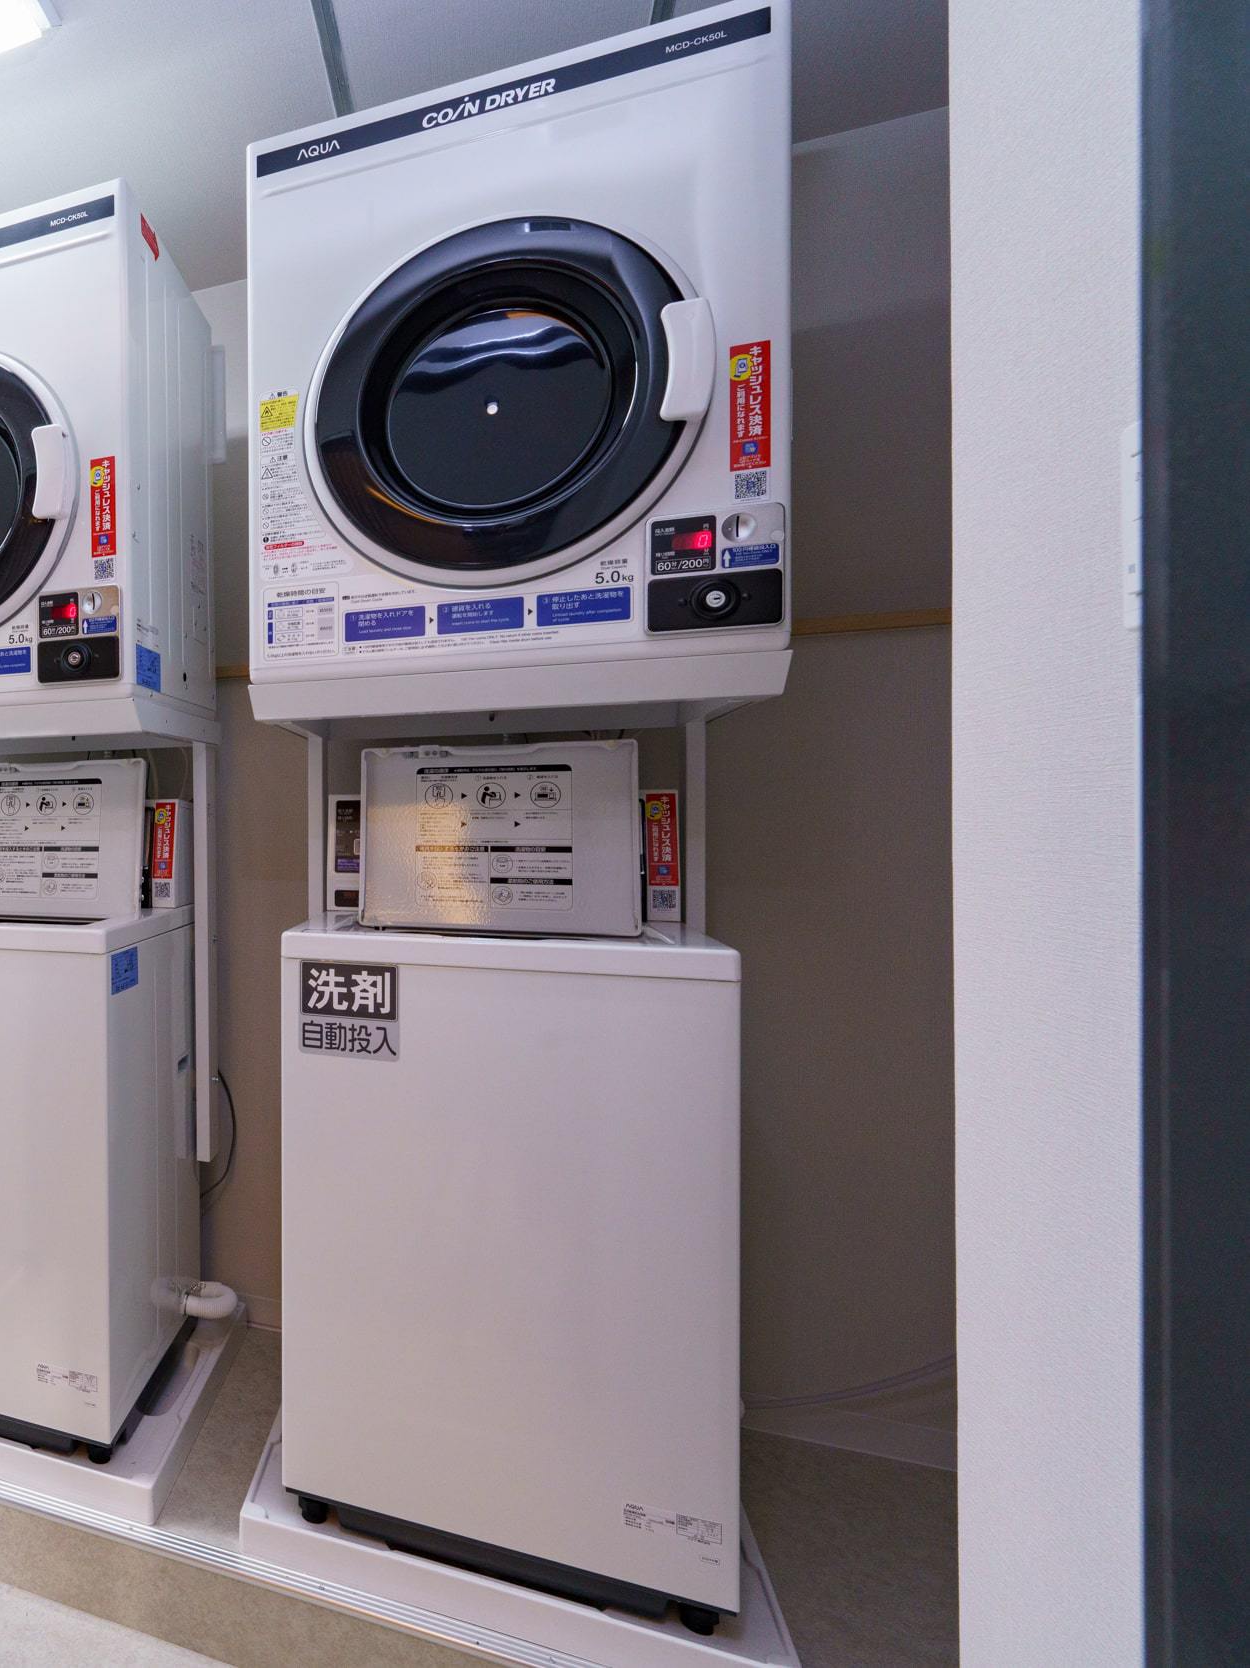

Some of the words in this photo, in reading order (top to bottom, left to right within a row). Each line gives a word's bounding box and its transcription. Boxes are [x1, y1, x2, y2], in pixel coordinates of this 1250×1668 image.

[665, 30, 727, 54] MCD-CK50L
[422, 96, 481, 129] COIN
[484, 78, 556, 111] DRYER
[296, 139, 341, 161] AQUA
[50, 210, 89, 227] MCD-CK50L
[749, 345, 763, 437] キャッシュレス決済
[101, 459, 111, 531] キャッシュレス決済
[698, 534, 709, 548] 0
[552, 591, 624, 603] 停止したあと洗濯物を
[552, 602, 580, 610] 取り出す
[307, 968, 391, 1014] 洗剤
[302, 1020, 397, 1056] 自動投入
